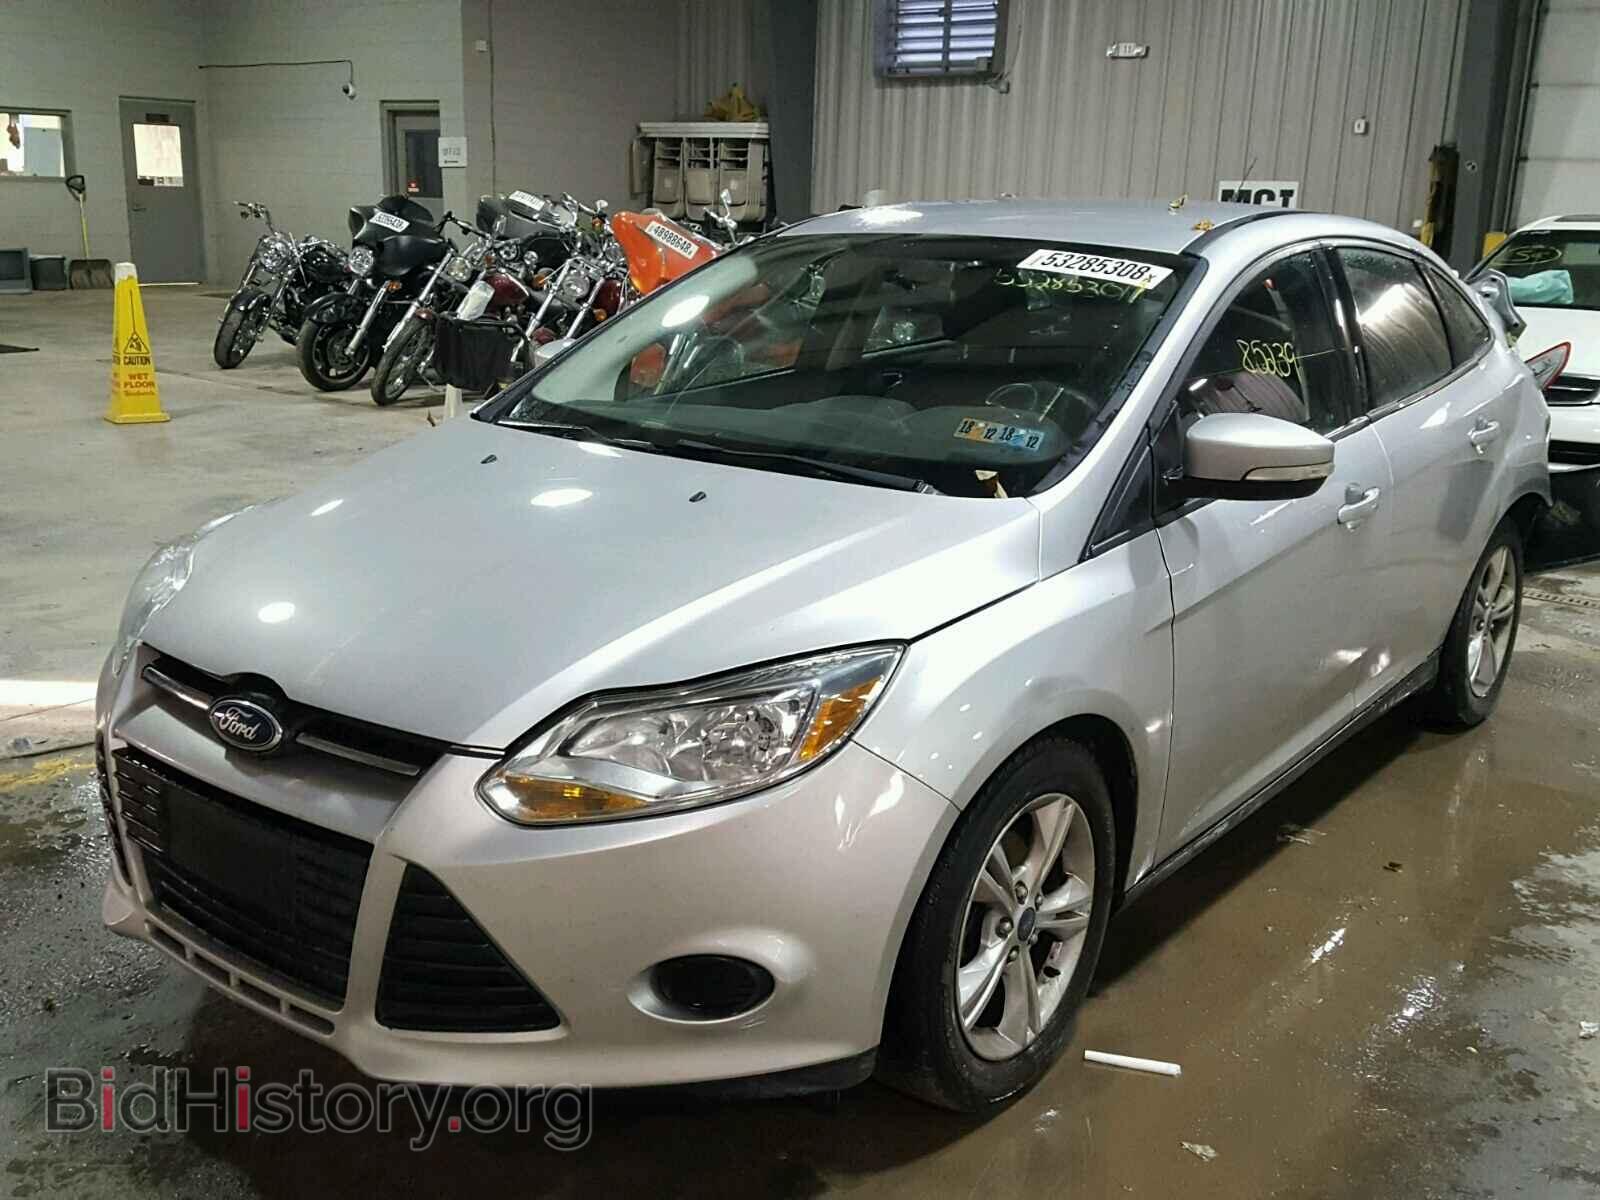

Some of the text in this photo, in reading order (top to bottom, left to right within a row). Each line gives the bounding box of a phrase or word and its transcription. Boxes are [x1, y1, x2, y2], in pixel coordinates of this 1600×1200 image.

[1041, 252, 1150, 280] 53285308
[123, 356, 151, 366] CAUTION
[123, 381, 156, 389] FLOOR
[958, 420, 976, 434] 18
[1000, 426, 1016, 441] 18
[1026, 435, 1040, 449] 12
[215, 706, 261, 740] Ford
